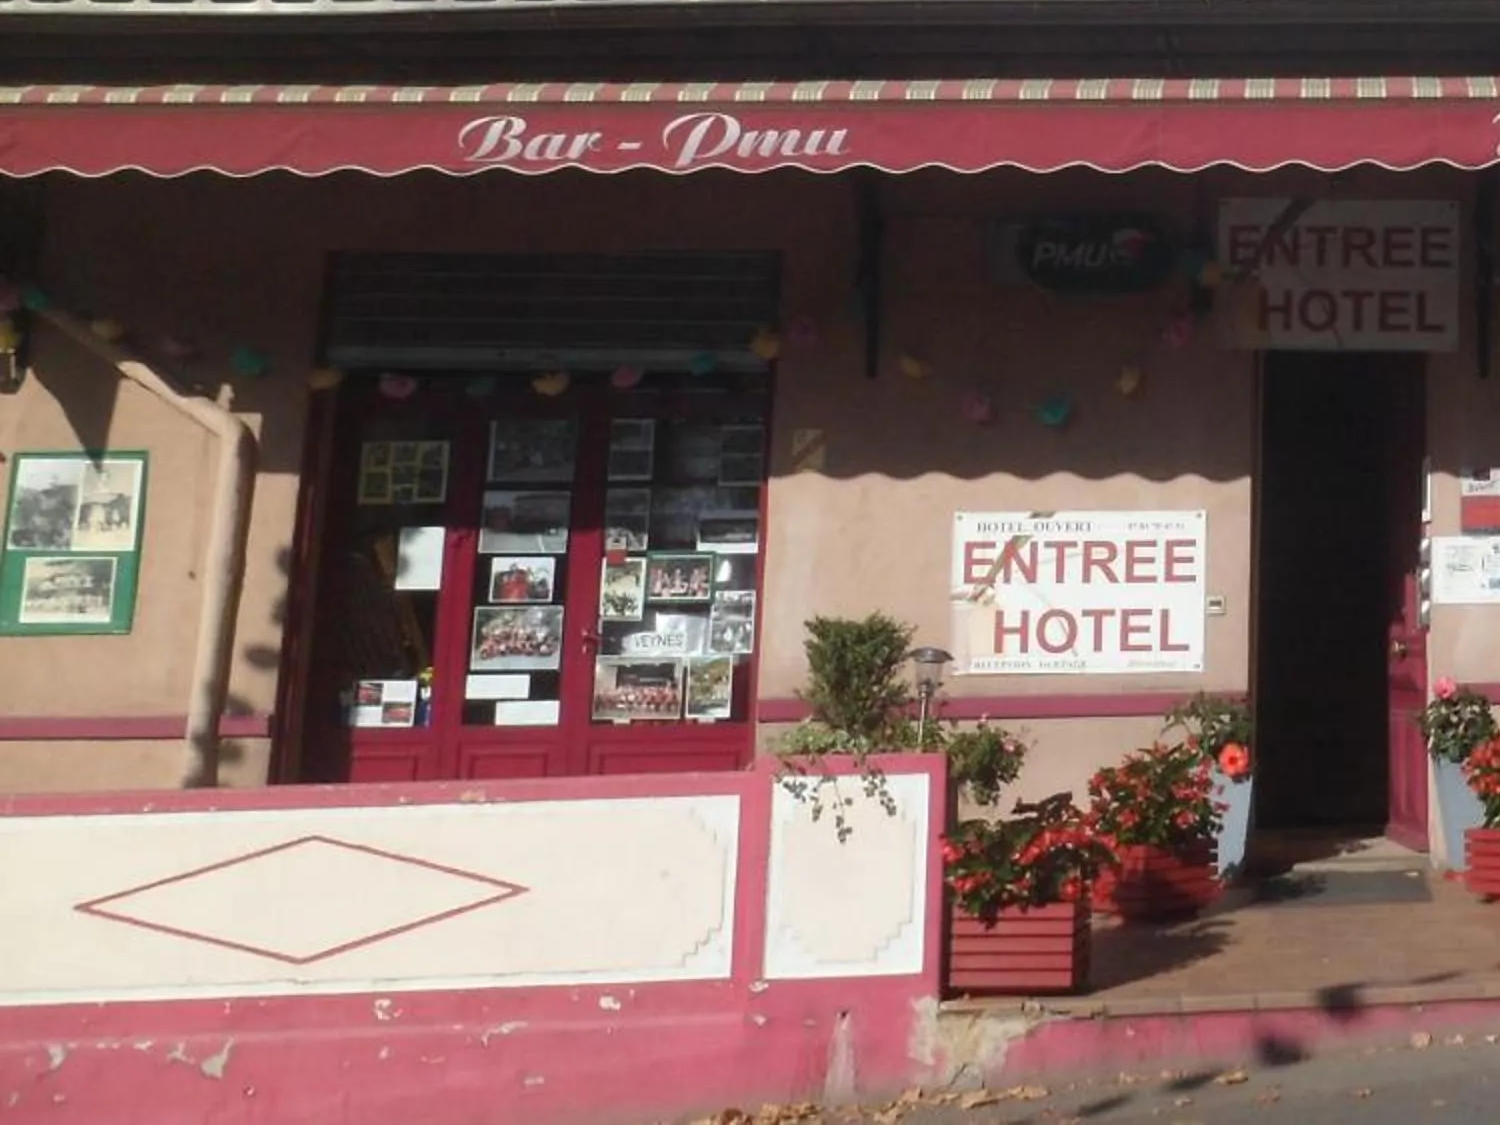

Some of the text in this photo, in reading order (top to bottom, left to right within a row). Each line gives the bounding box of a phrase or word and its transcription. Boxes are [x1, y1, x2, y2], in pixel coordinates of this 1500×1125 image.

[458, 115, 602, 162] Bar
[663, 112, 852, 168] Pmu
[1228, 226, 1452, 268] ENTREE
[1258, 288, 1446, 332] HOTEL
[963, 539, 1197, 583] ENTREE
[994, 608, 1190, 654] HOTEL
